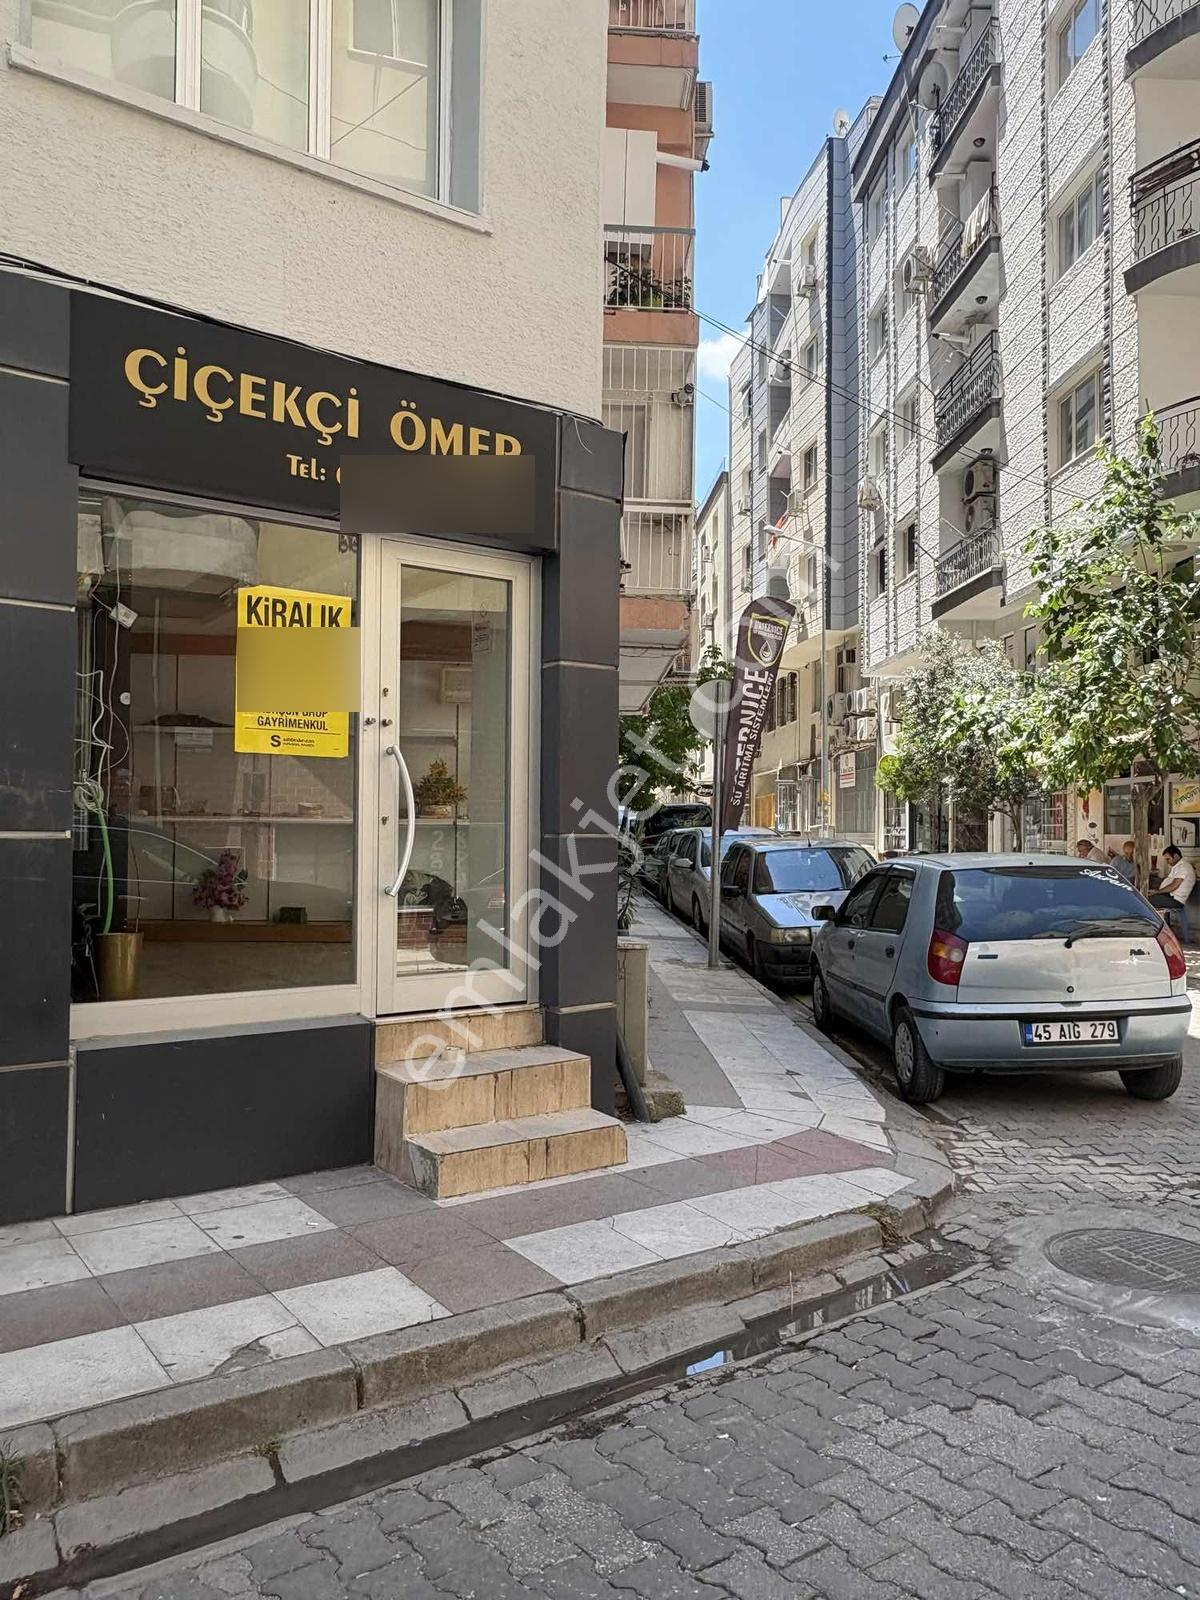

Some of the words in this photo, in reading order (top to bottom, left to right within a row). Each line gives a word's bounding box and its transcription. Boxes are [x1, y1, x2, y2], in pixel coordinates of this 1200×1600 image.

[124, 346, 360, 446] ÇİÇEKÇİ
[257, 715, 329, 731] GAYRİMENKUL
[1034, 1024, 1052, 1041] 45
[1059, 1023, 1081, 1040] AIG
[1089, 1022, 1116, 1039] 279
